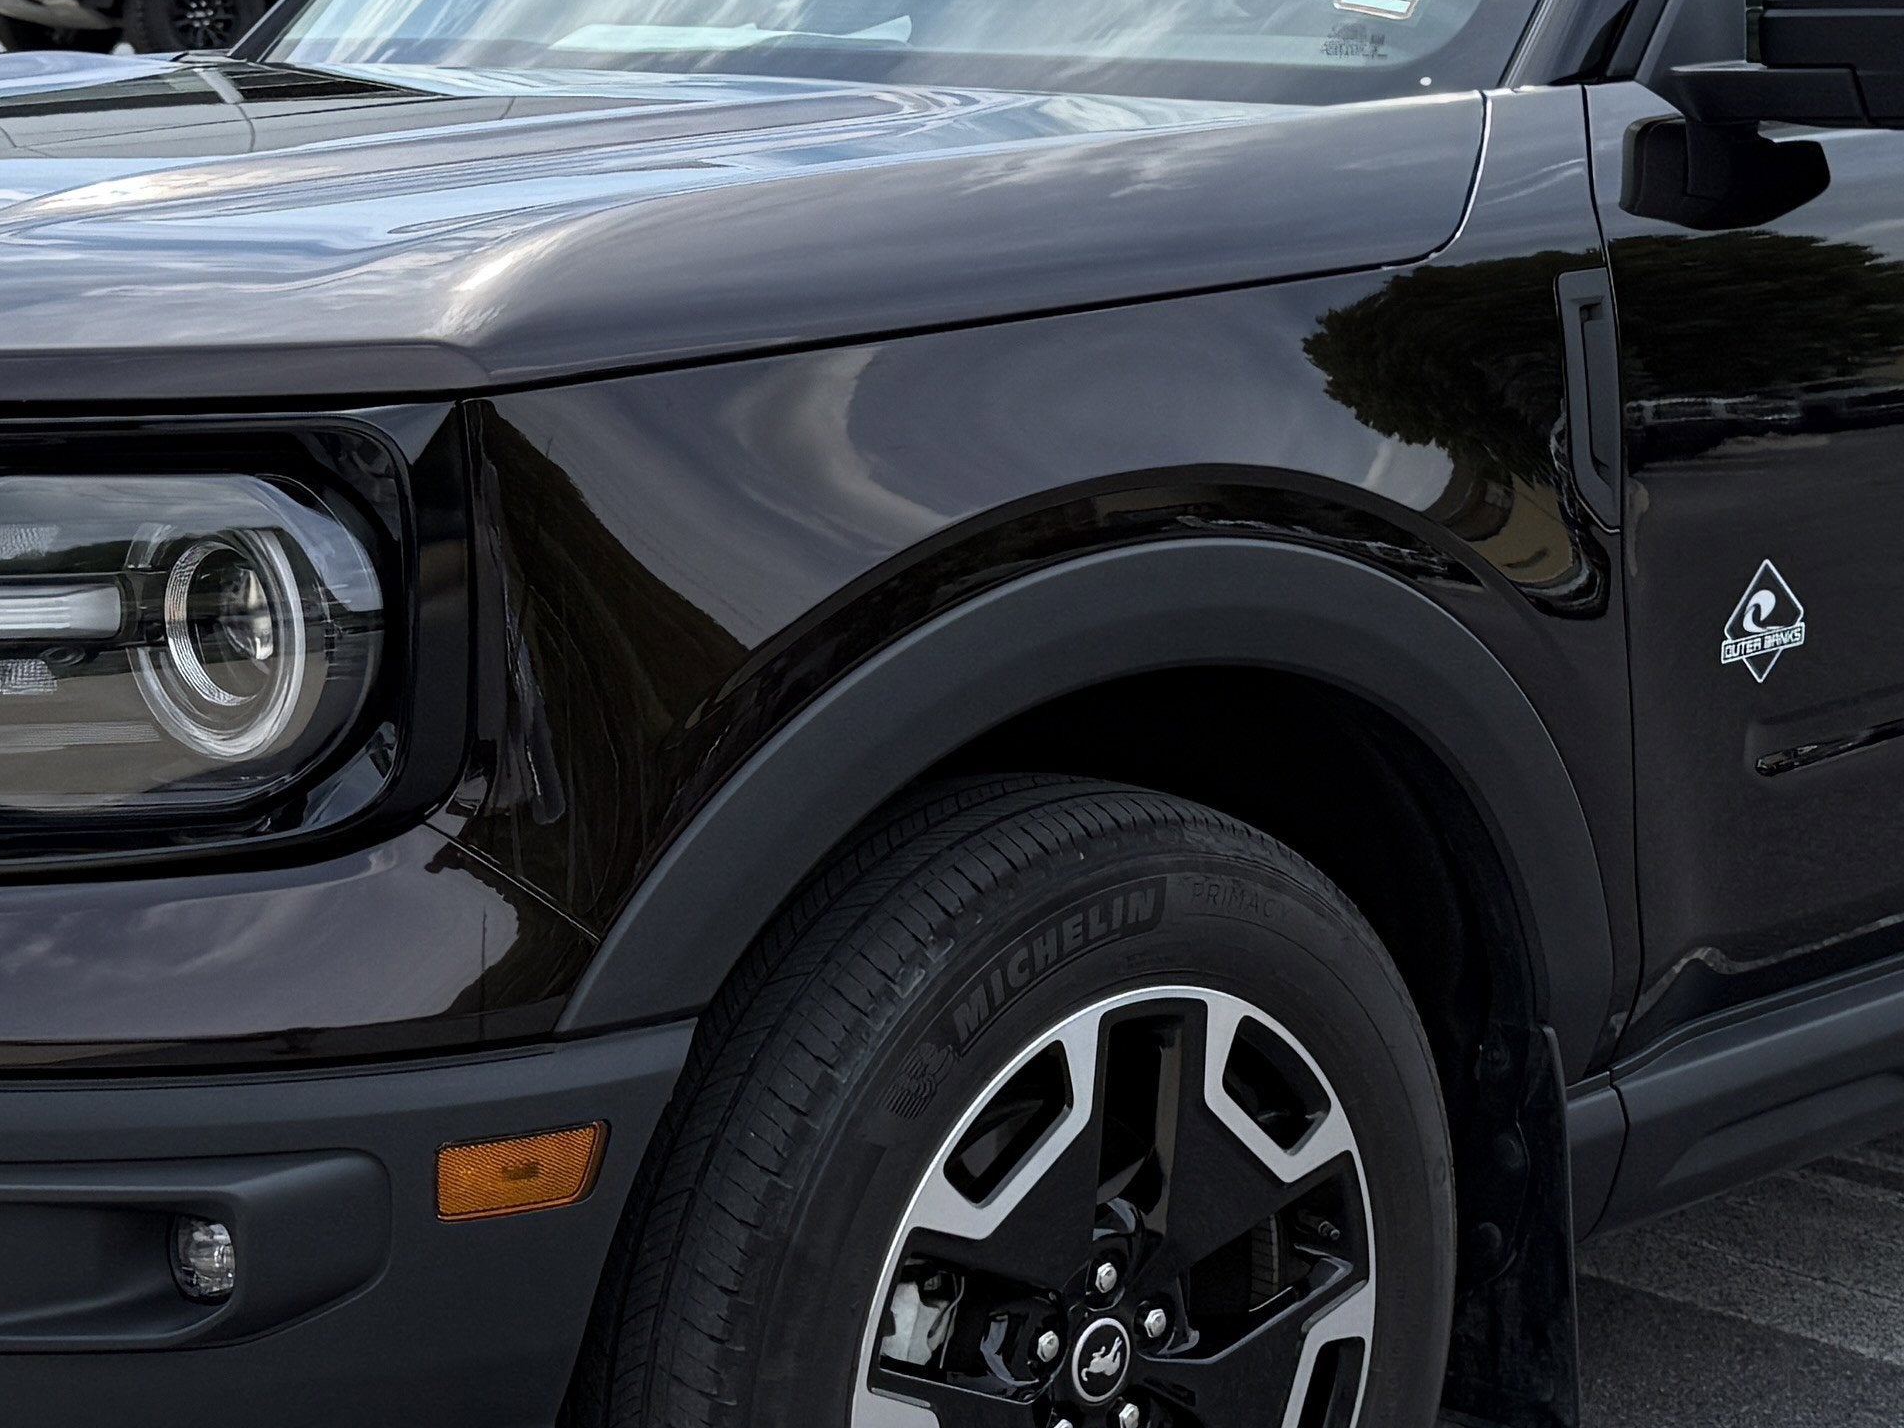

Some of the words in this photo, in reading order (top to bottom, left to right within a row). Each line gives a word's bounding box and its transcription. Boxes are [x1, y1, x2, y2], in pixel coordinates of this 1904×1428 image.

[1724, 637, 1762, 658] OUTER
[1764, 627, 1802, 649] BANKS
[951, 885, 1158, 1043] MICHELIN
